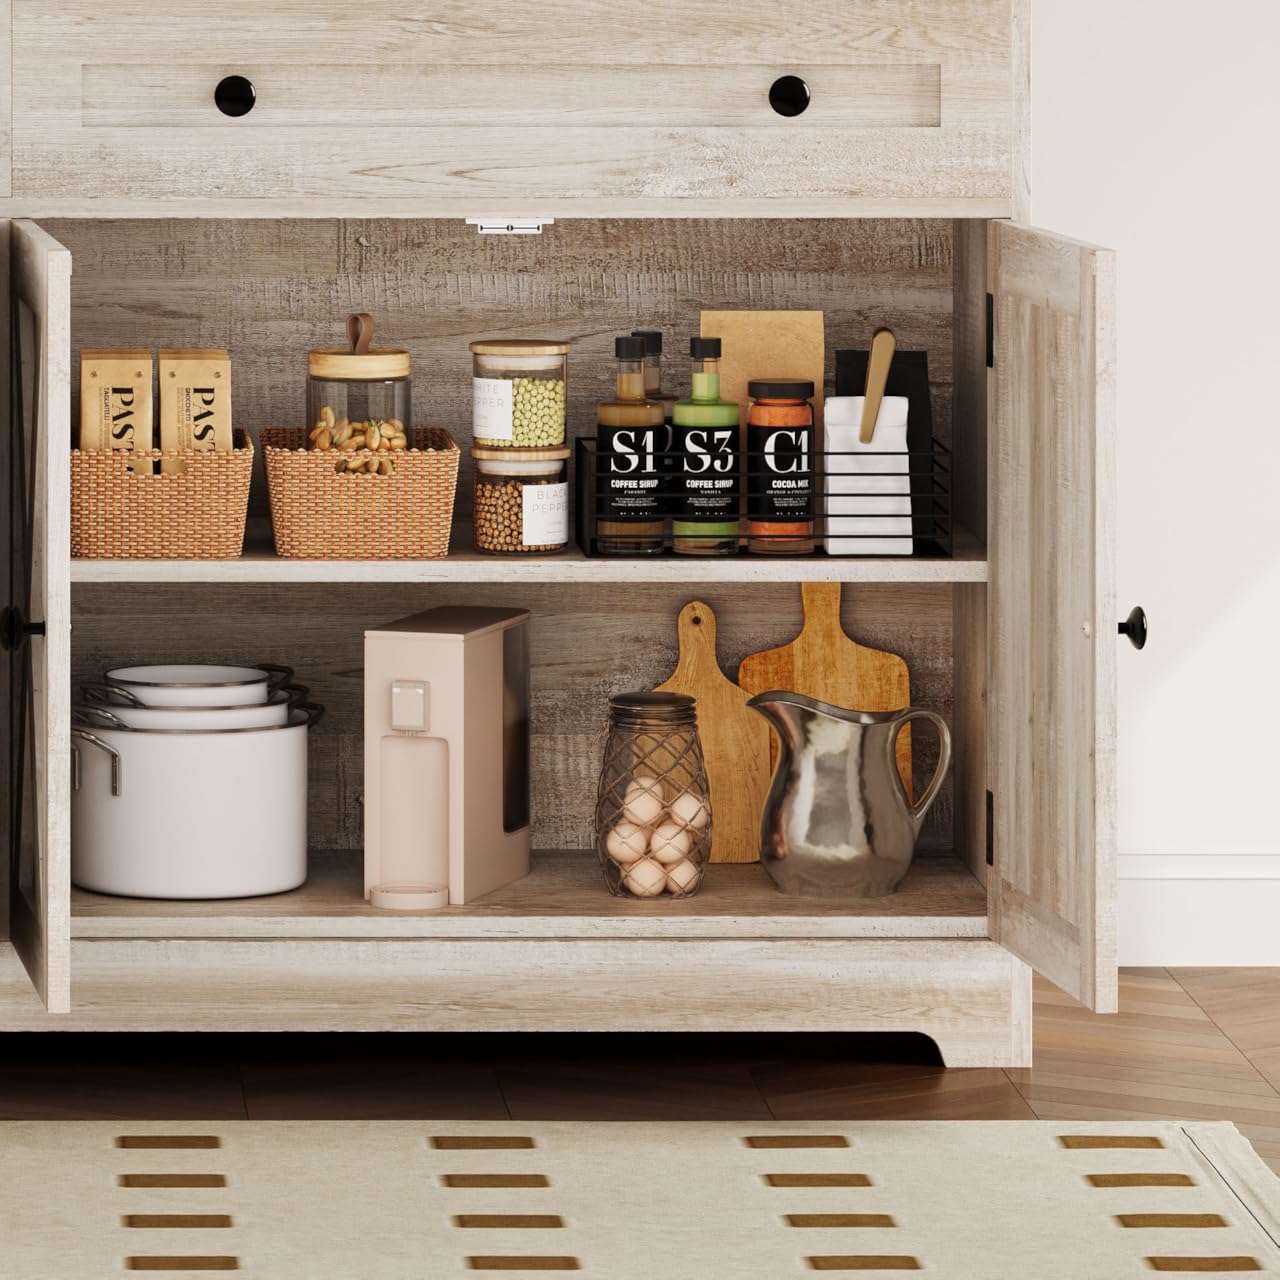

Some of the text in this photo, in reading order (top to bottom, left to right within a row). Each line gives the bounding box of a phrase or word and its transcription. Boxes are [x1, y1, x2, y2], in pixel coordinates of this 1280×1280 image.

[111, 387, 135, 452] PAST
[192, 387, 216, 452] PAST
[610, 430, 657, 474] S1
[683, 430, 734, 474] S3
[763, 430, 811, 474] C1
[610, 479, 659, 489] COFFEE SIRUP
[686, 479, 734, 489] COFFEE SIRUP
[771, 479, 809, 489] COCOA MIX
[532, 501, 568, 513] PEPPE
